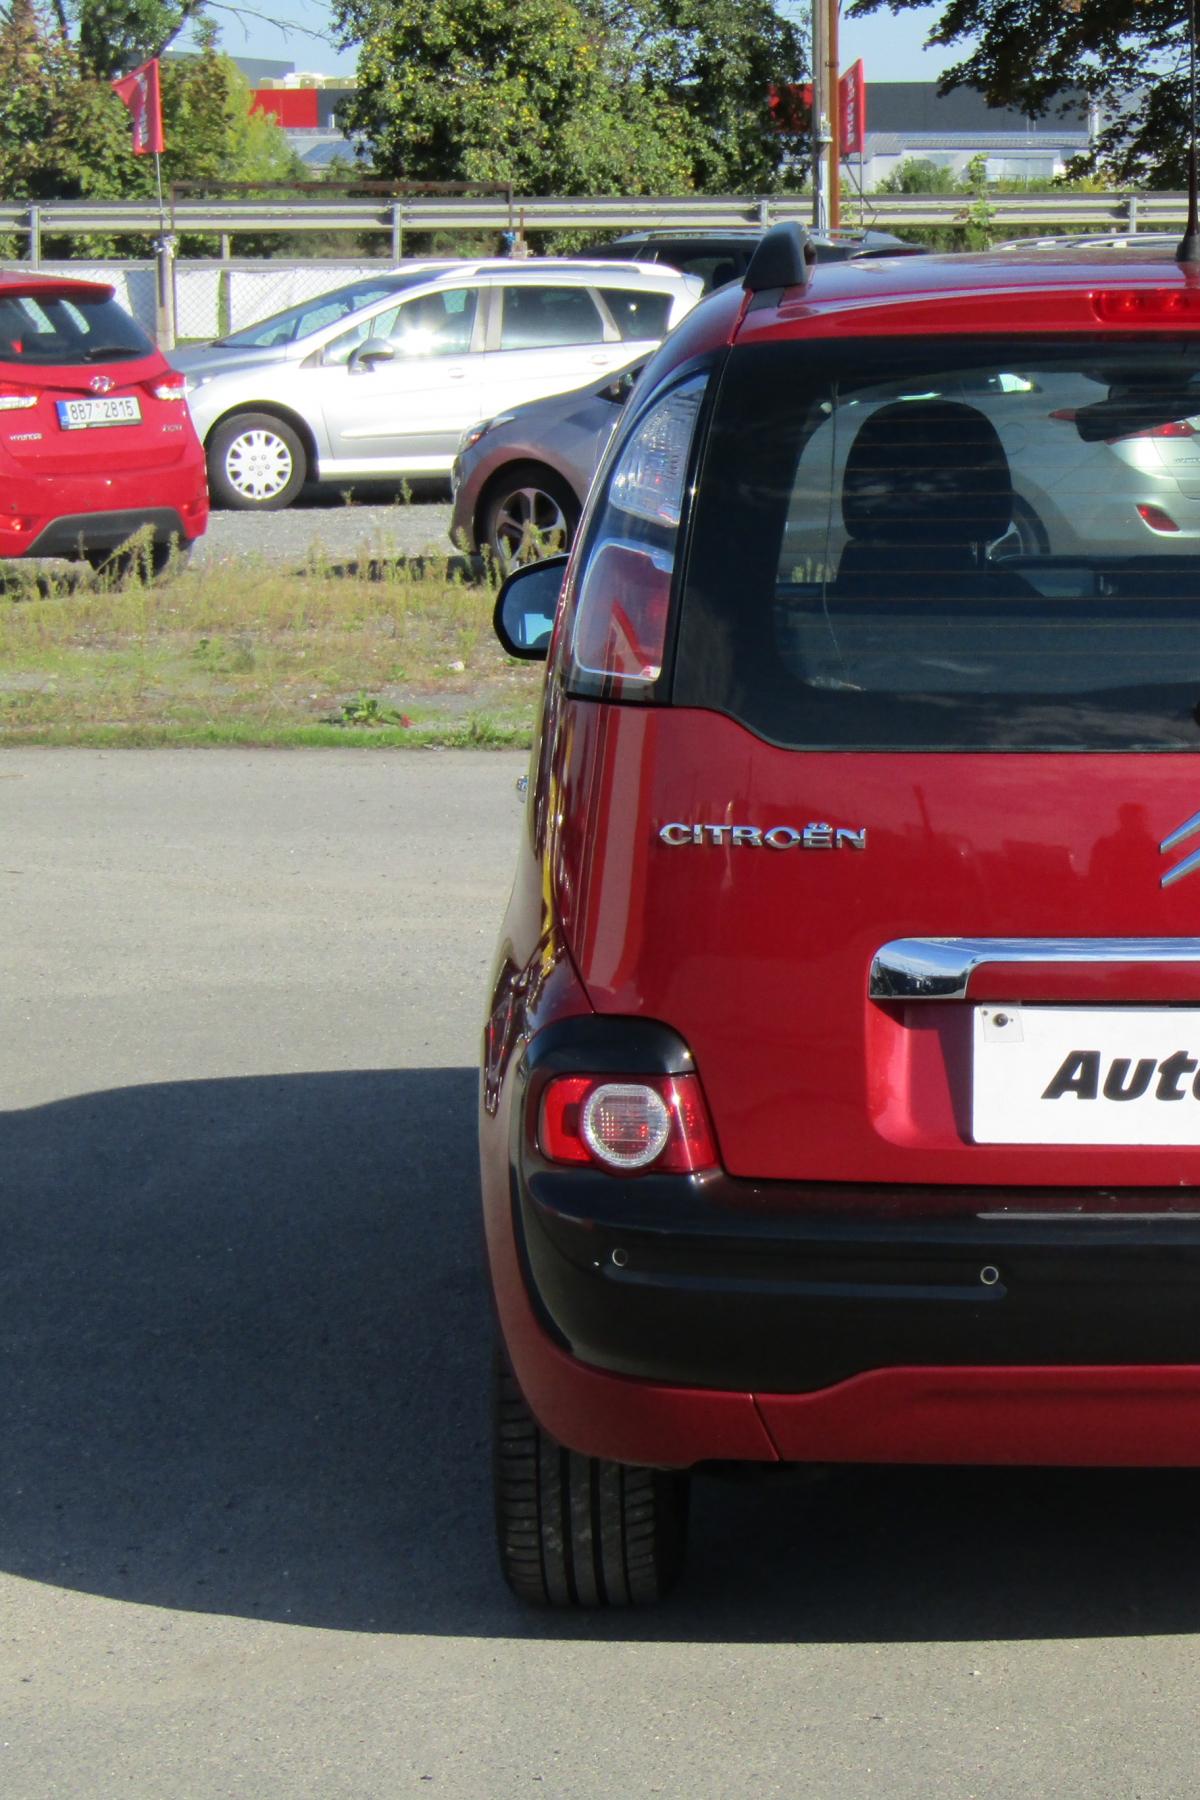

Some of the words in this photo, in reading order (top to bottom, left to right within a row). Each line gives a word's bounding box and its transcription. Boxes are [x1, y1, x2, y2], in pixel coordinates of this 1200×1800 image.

[70, 401, 93, 421] 8B7
[104, 400, 134, 418] 2815
[659, 822, 867, 849] CITROËN
